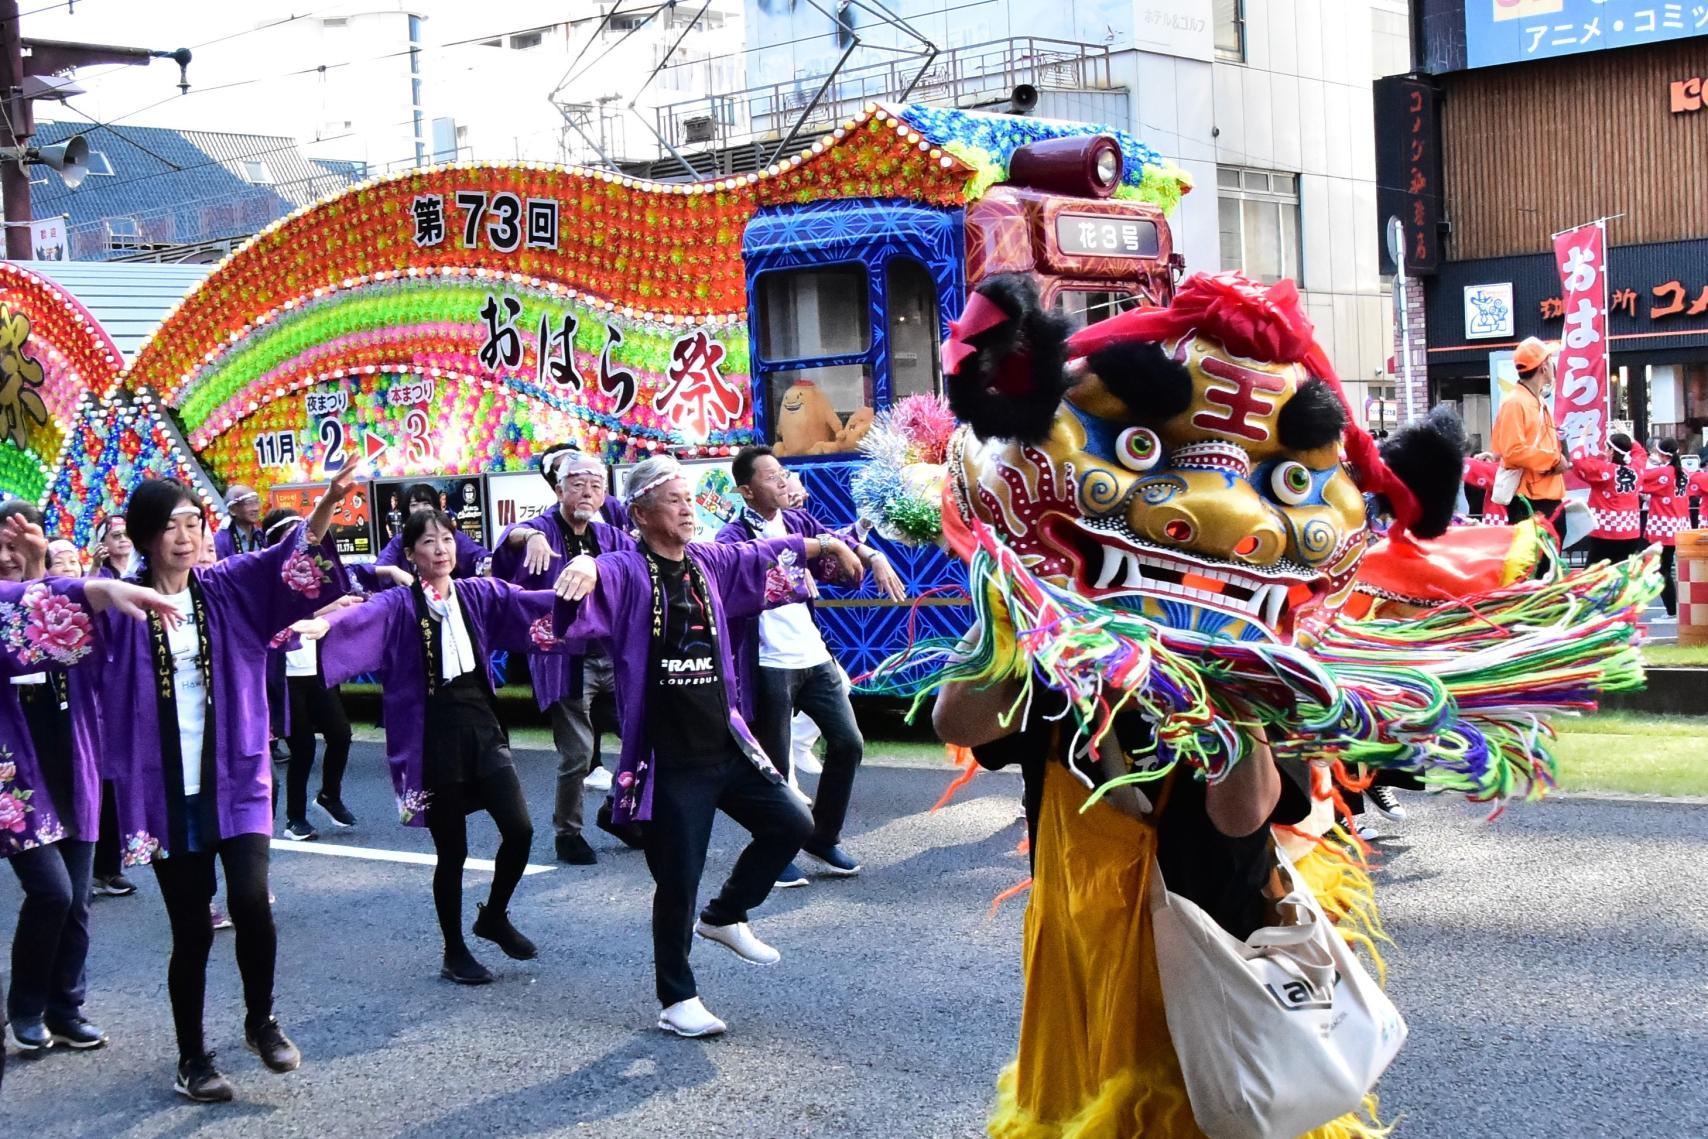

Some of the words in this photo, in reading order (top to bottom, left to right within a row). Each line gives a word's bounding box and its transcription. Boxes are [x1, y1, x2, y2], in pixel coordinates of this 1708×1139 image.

[412, 191, 558, 252] 第73回
[1078, 221, 1139, 251] 花3号
[479, 293, 746, 438] おはら祭
[306, 391, 348, 415] 夜まつり
[391, 382, 433, 405] 本まつり
[255, 433, 296, 465] 11月
[321, 419, 346, 472] 2
[407, 413, 431, 464] 3
[1615, 465, 1640, 493] 祭
